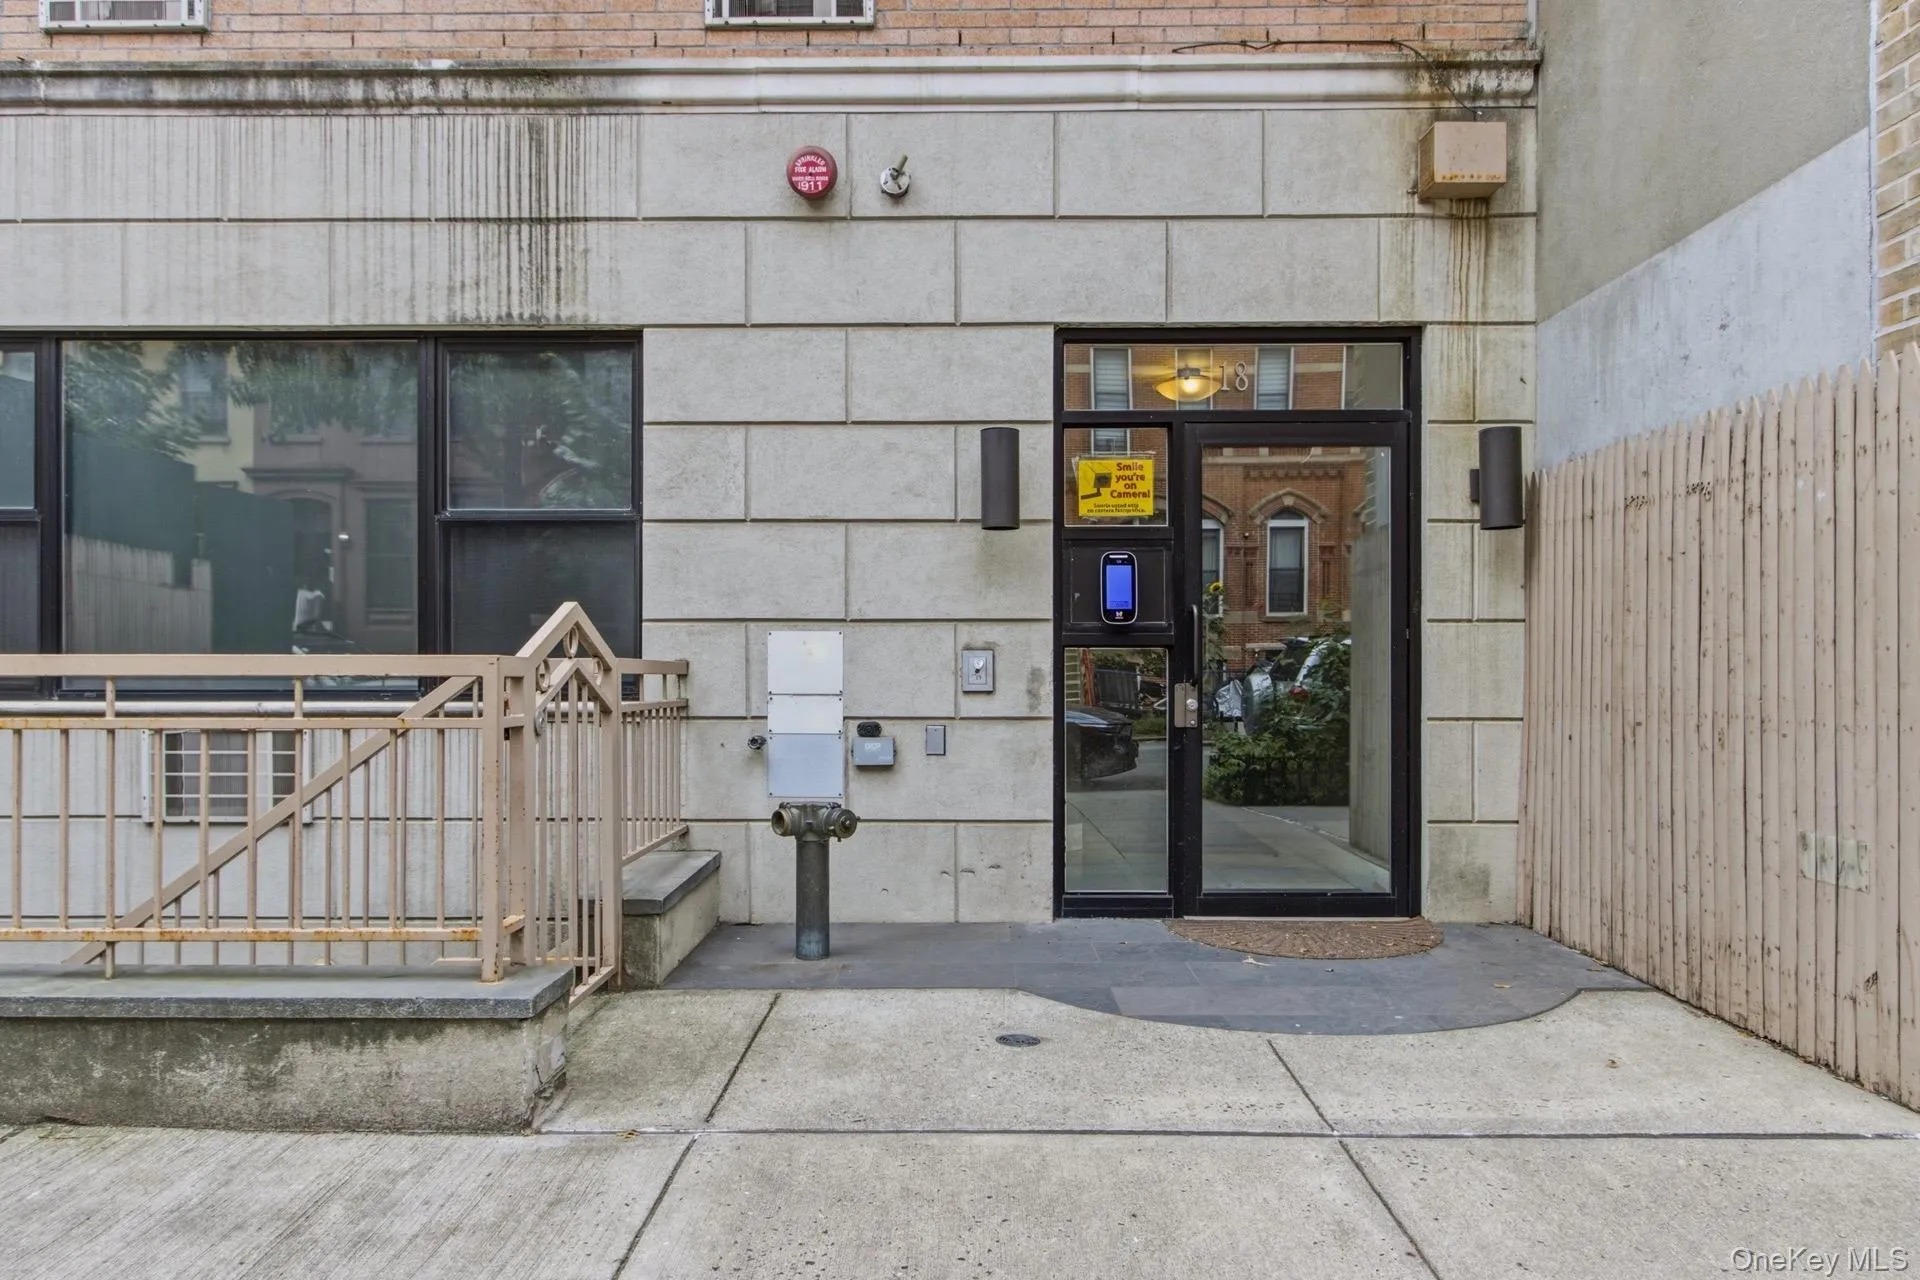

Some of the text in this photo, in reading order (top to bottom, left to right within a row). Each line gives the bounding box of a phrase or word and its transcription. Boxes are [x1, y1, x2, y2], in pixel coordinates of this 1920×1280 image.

[1219, 360, 1249, 391] 18
[1116, 462, 1144, 472] Smile
[1115, 473, 1146, 483] you're
[1124, 482, 1137, 490] on
